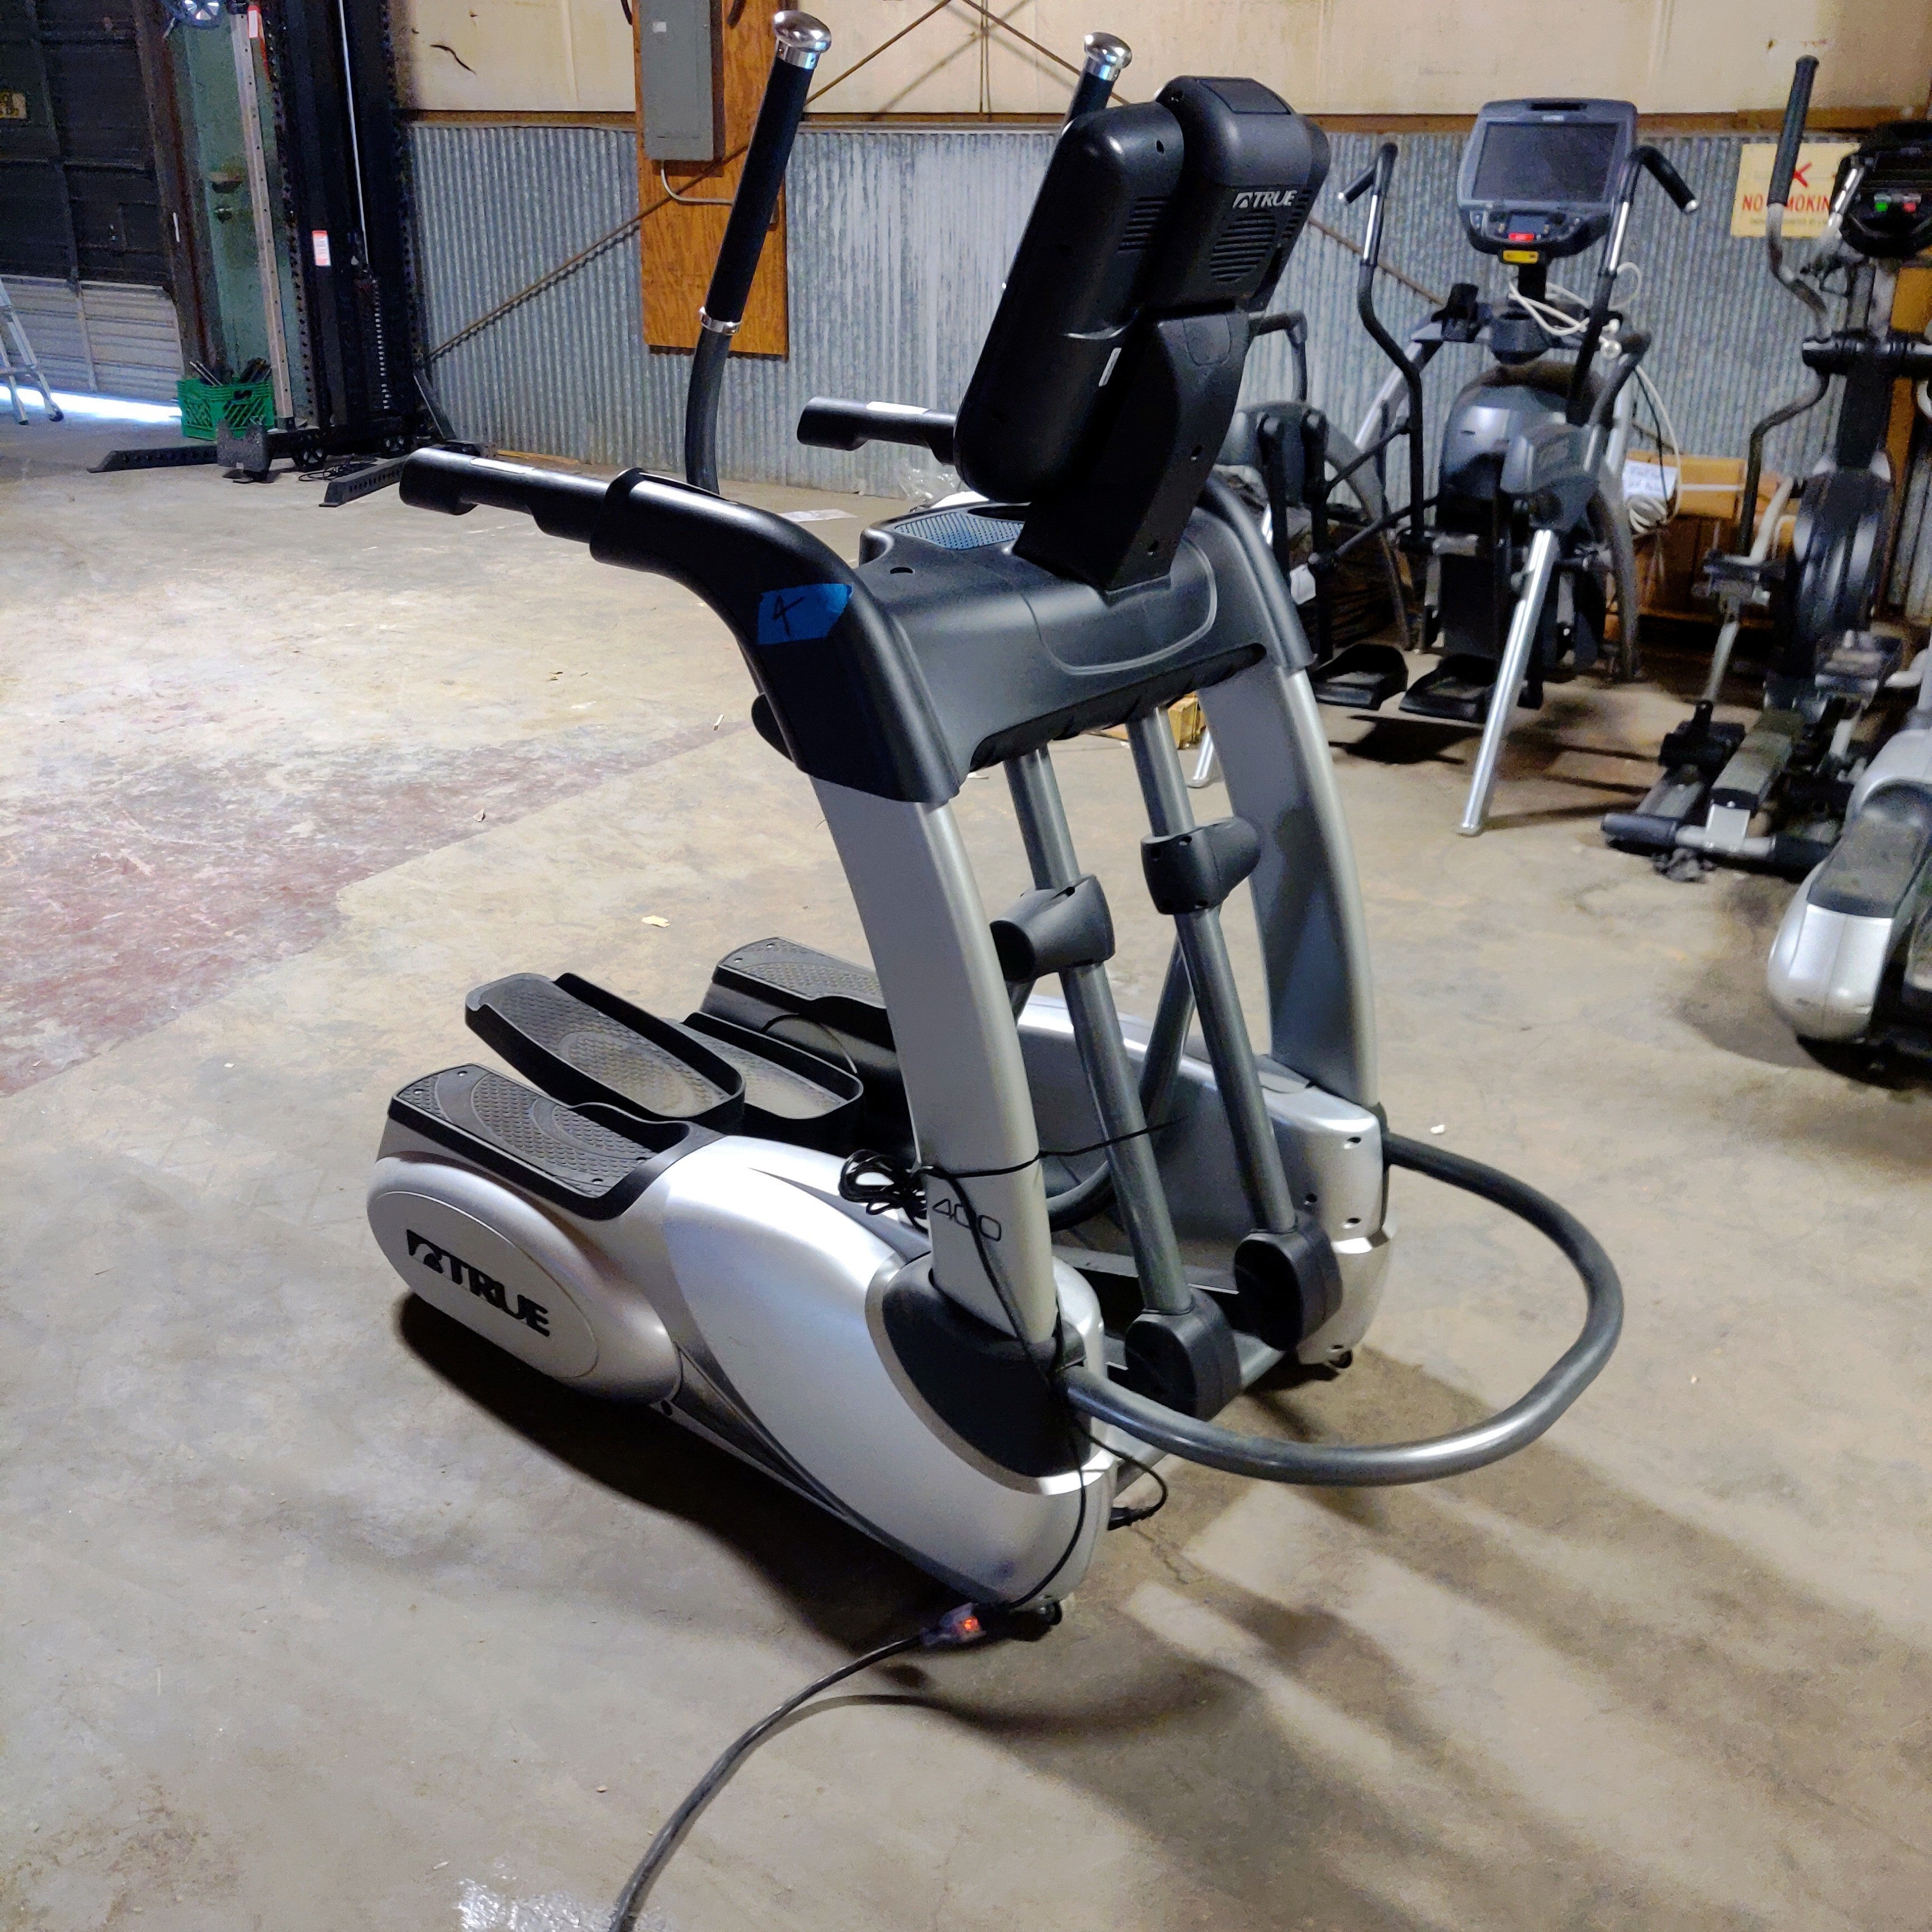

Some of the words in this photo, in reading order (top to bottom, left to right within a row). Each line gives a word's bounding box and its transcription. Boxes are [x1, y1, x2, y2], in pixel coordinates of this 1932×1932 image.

[1253, 190, 1297, 208] TRUE
[1742, 194, 1763, 212] NO
[932, 1198, 1002, 1242] 400
[443, 1250, 550, 1337] TRUE
